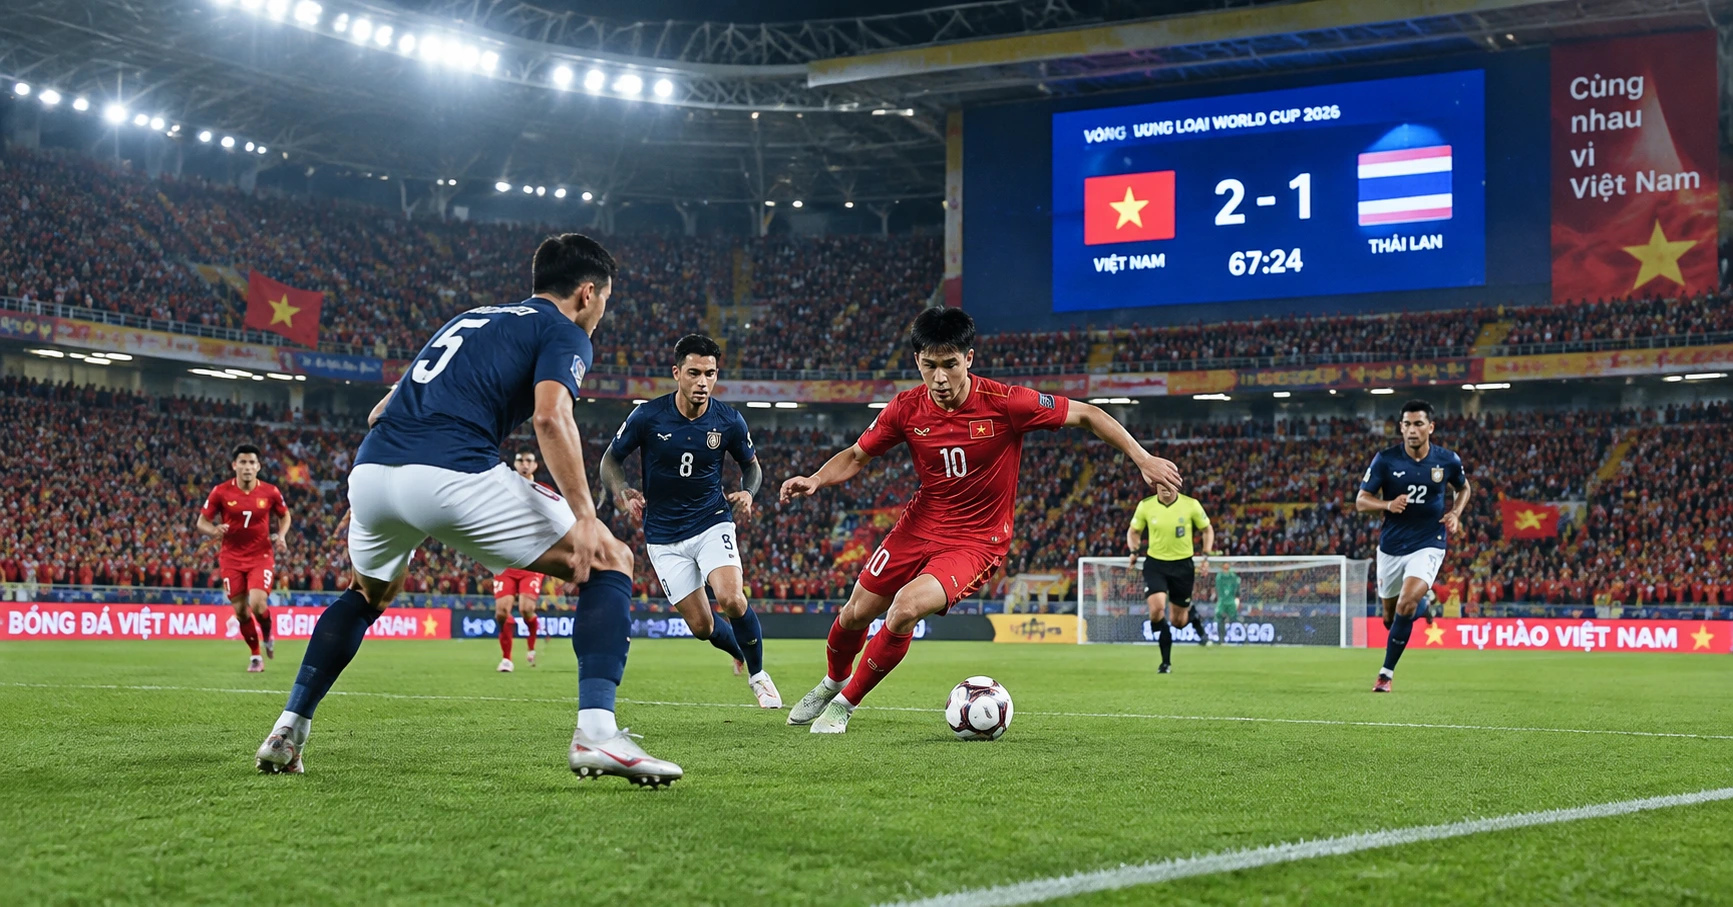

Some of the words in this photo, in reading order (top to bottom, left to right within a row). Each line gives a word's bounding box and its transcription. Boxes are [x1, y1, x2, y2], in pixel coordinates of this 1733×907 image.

[1212, 112, 1267, 130] WORLD
[1269, 108, 1301, 125] CUP
[1303, 104, 1341, 122] 2026
[1571, 108, 1642, 133] nhau
[1215, 178, 1246, 226] 2
[1289, 172, 1311, 220] 1
[1570, 173, 1627, 203] Việt
[1636, 170, 1700, 193] Nam
[1409, 233, 1443, 251] LAN
[1093, 253, 1128, 274] VIỆT
[1129, 253, 1166, 270] NAM
[1228, 248, 1304, 277] 67:24
[412, 318, 490, 384] 5
[679, 452, 694, 477] 8
[939, 447, 968, 478] 10
[1406, 485, 1428, 504] 22
[242, 510, 253, 528] 7
[117, 606, 165, 640] VIỆT
[169, 612, 217, 635] NAM
[1456, 622, 1492, 650] TỰ
[1496, 619, 1549, 647] HÀO
[1555, 620, 1611, 652] VIỆT
[1617, 626, 1678, 648] NAM
